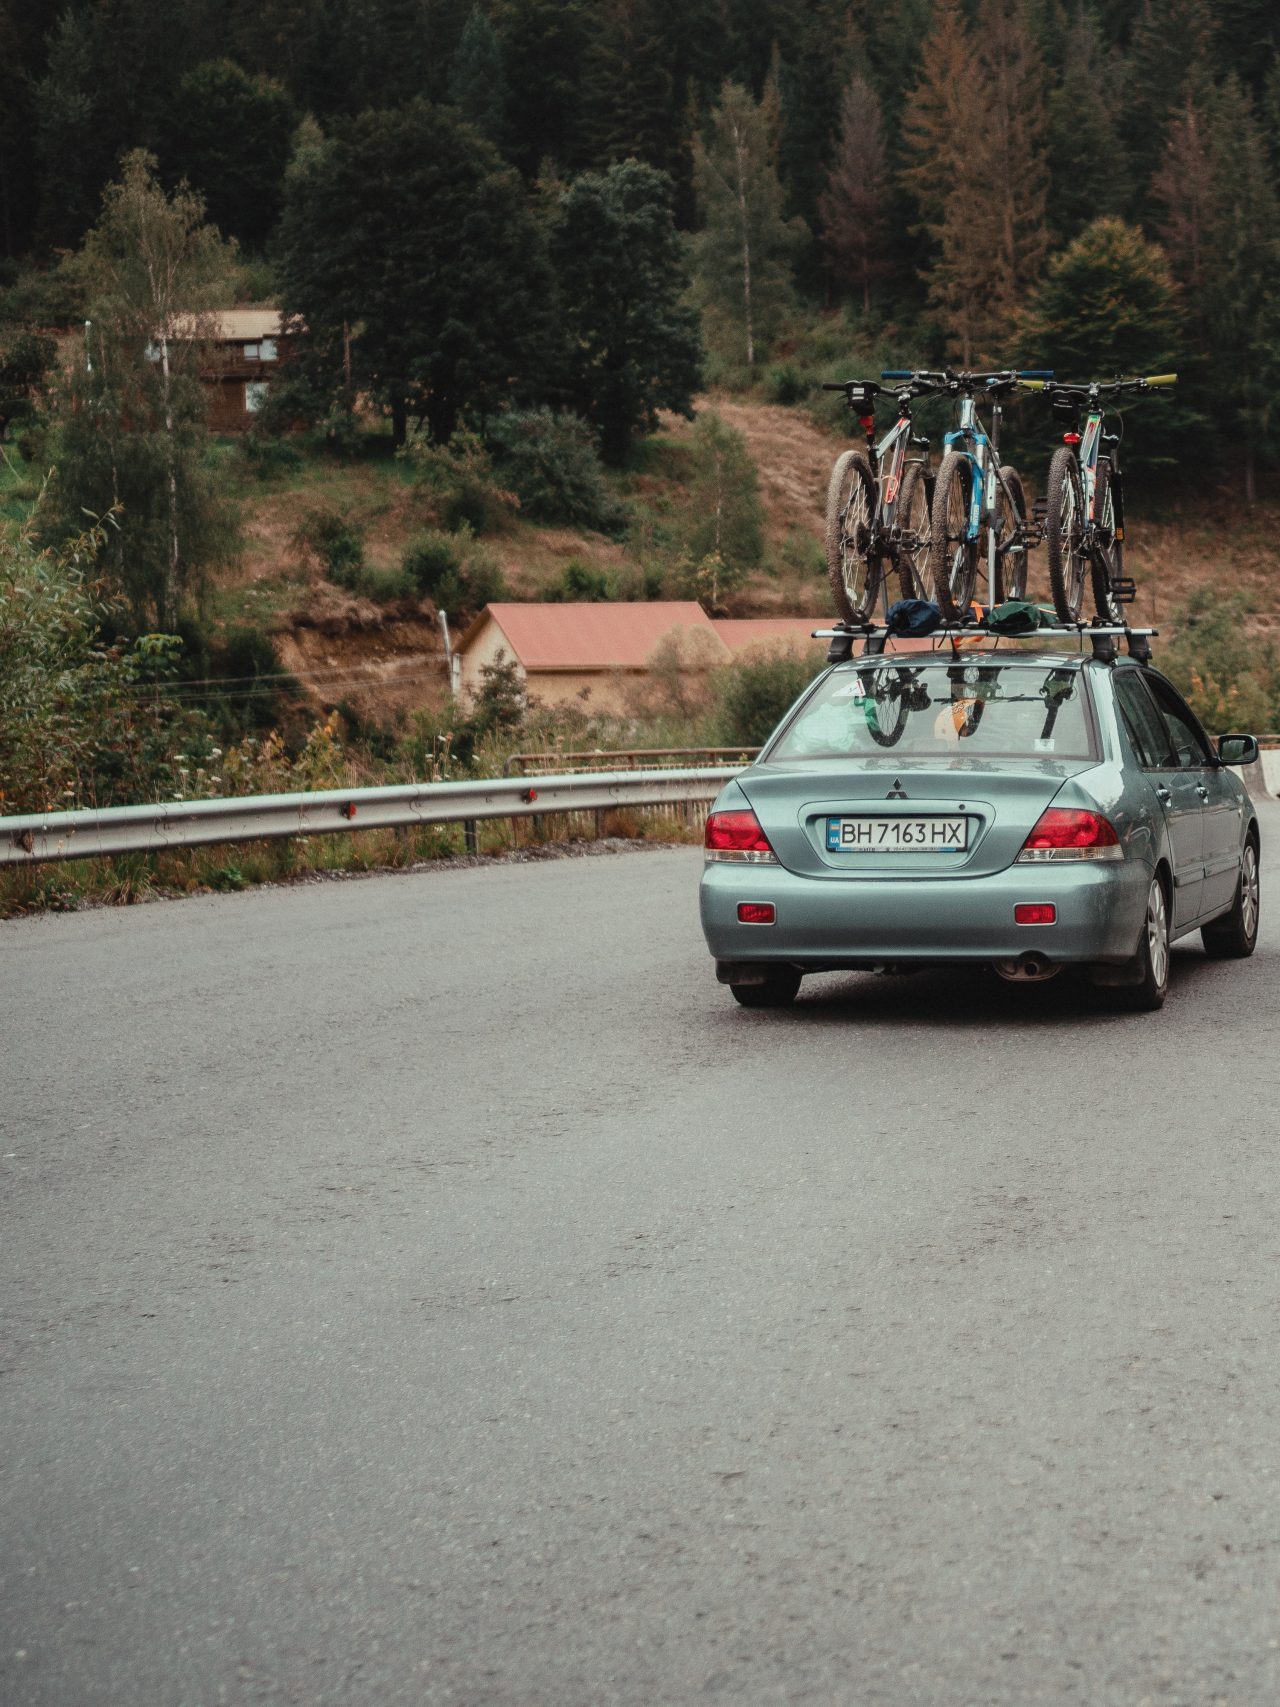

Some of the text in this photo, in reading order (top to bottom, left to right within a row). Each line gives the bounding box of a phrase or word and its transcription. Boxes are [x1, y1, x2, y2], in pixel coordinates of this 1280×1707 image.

[830, 836, 840, 844] UA
[842, 823, 962, 844] BH 7163 HX
